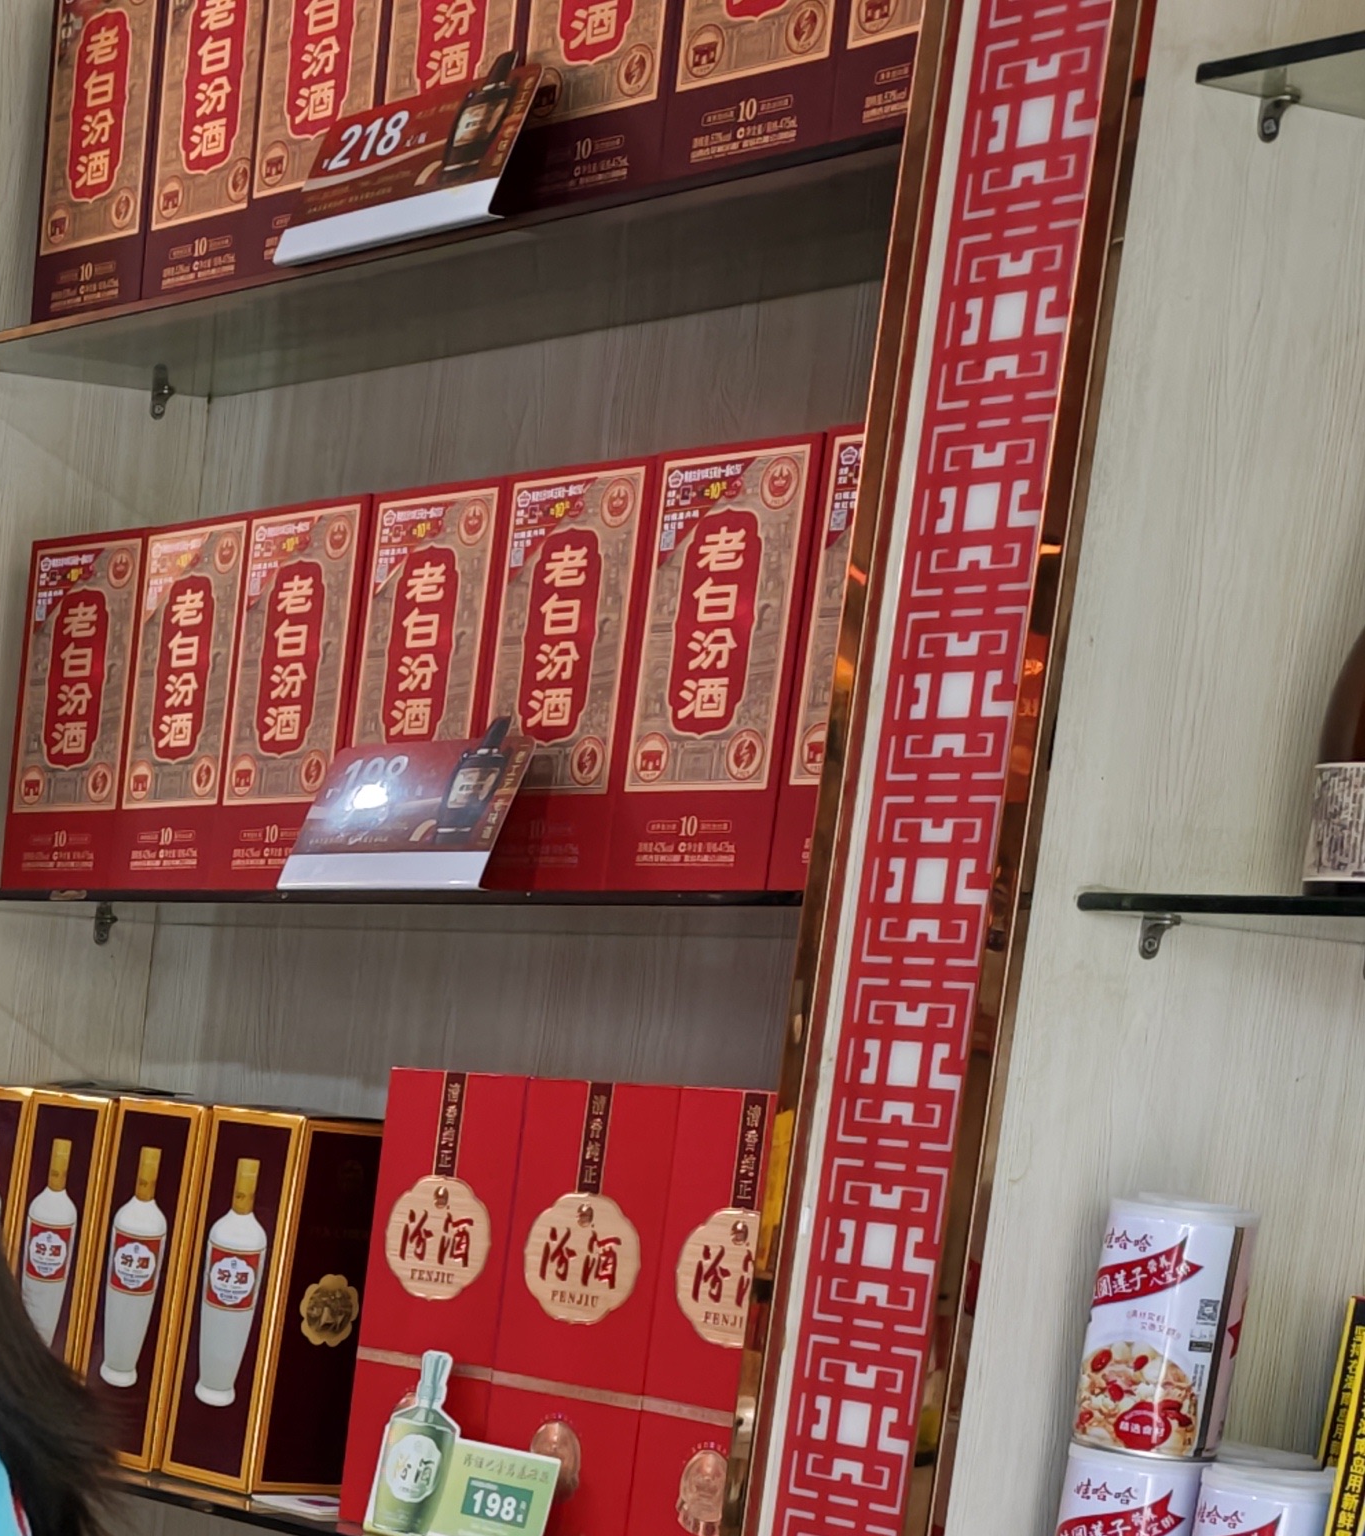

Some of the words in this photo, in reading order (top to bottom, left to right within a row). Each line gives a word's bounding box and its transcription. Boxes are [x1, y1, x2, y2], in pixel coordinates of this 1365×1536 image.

[294, 0, 341, 123] 白汾酒
[425, 0, 474, 89] 汾酒
[75, 26, 120, 190] 老白汾酒
[189, 0, 237, 161] 老白汾酒
[737, 98, 757, 122] 10
[327, 110, 409, 172] 218
[193, 236, 208, 256] 10
[391, 562, 446, 736] 老白汾酒
[527, 545, 588, 727] 老白汾酒
[679, 526, 746, 719] 老白汾酒
[51, 602, 97, 754] 老白汾酒
[159, 588, 204, 747] 老白汾酒
[263, 575, 314, 741] 老白汾酒
[160, 828, 173, 844] 10
[265, 825, 278, 842] 10
[679, 816, 697, 836] 10
[399, 1208, 474, 1268] 汾酒
[539, 1227, 622, 1290] 汾酒
[410, 1268, 454, 1285] FENJIU
[550, 1290, 600, 1308] FENJIU
[703, 1312, 743, 1330] FENJI
[472, 1489, 516, 1522] 198
[1076, 1478, 1138, 1505] 娃哈哈
